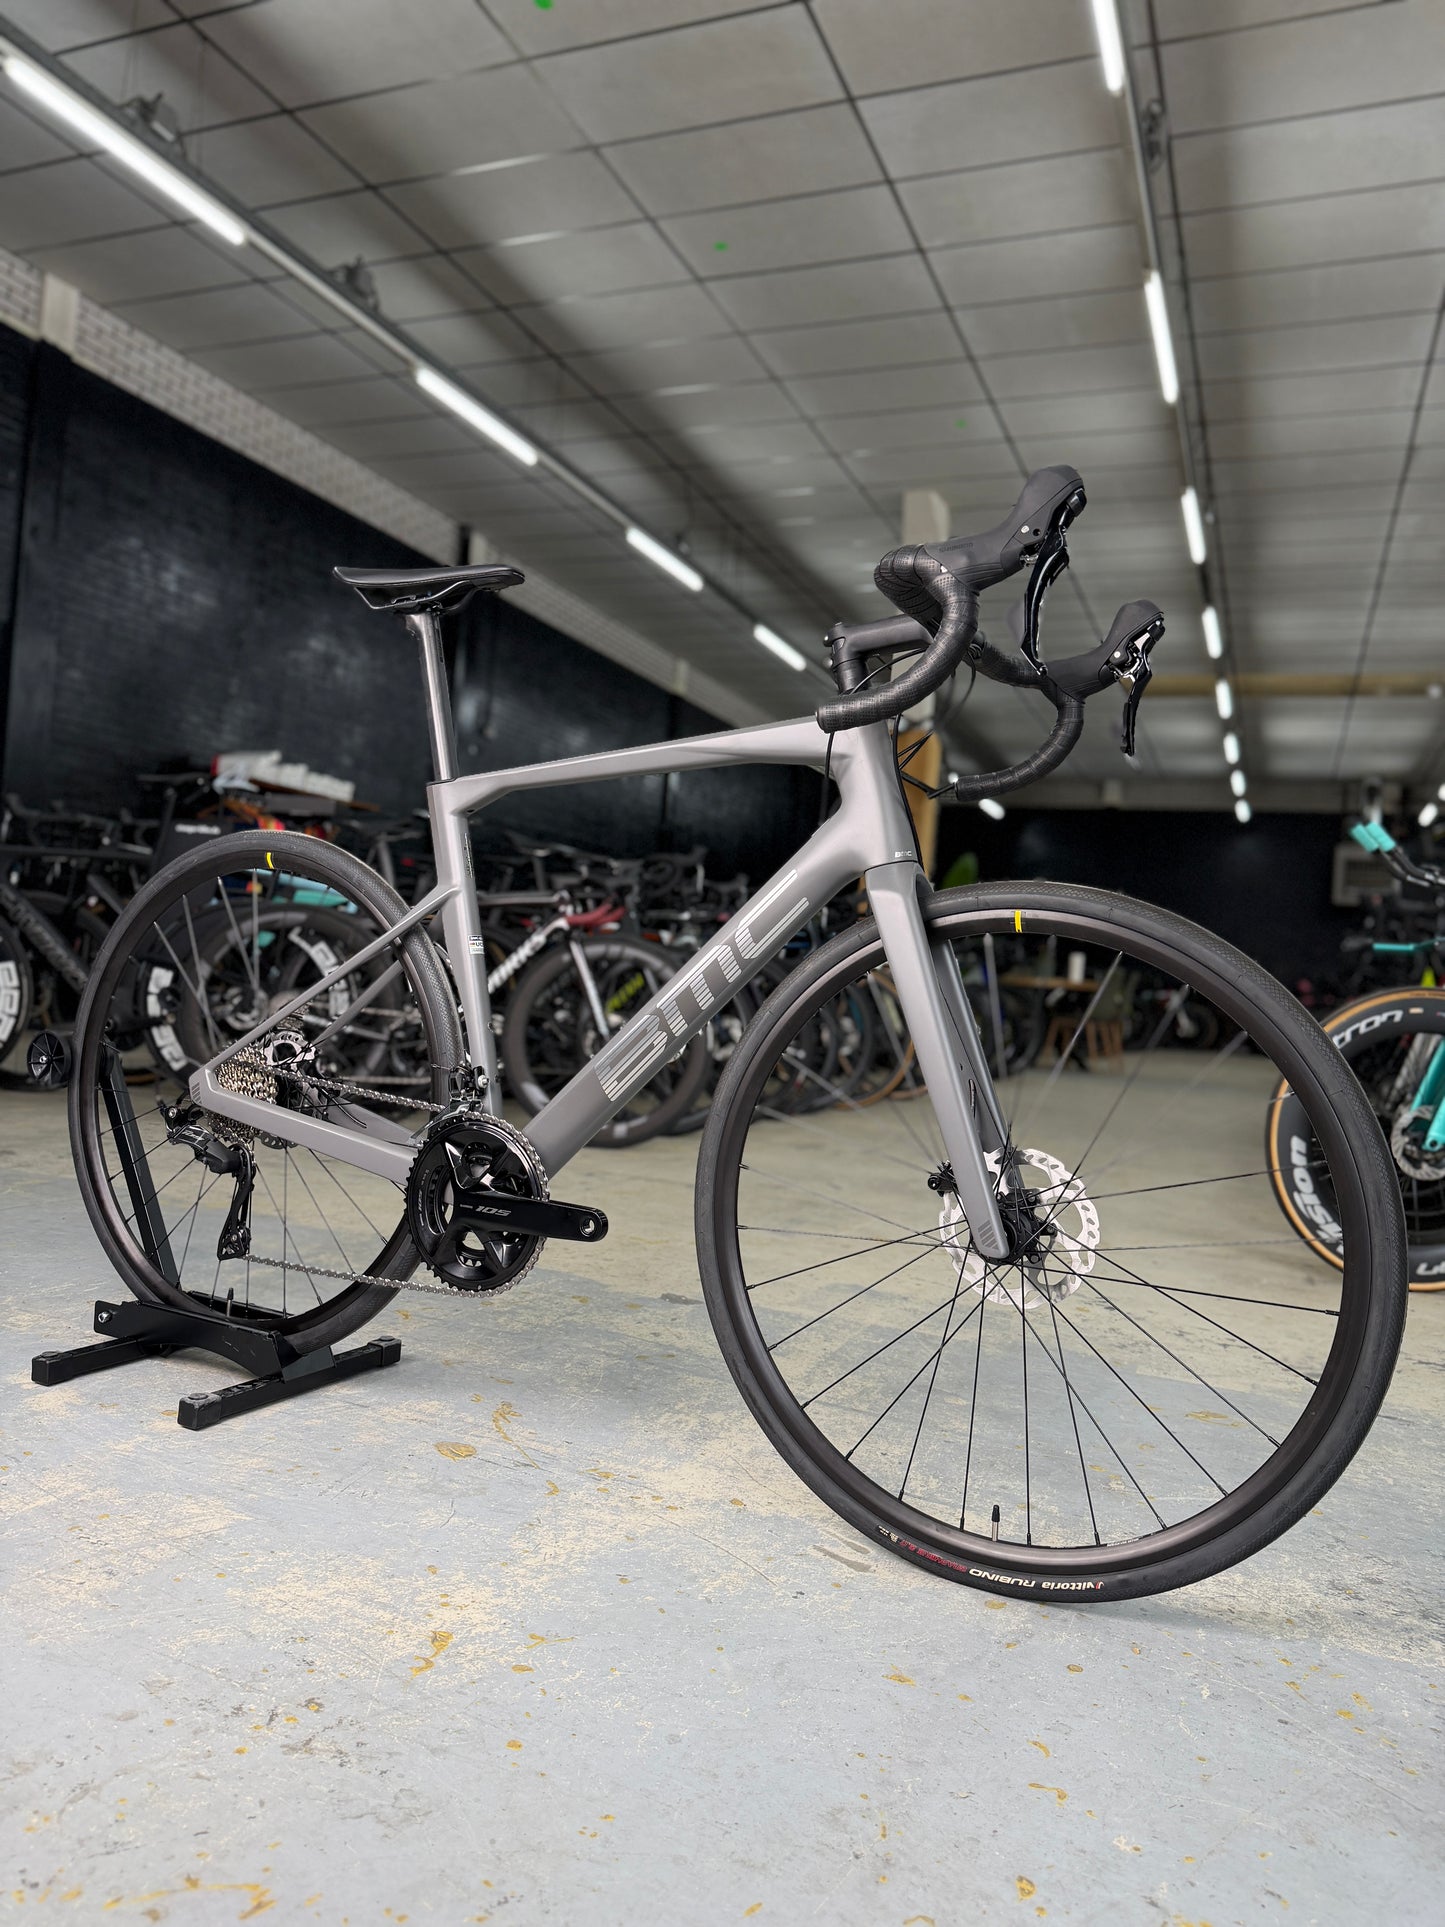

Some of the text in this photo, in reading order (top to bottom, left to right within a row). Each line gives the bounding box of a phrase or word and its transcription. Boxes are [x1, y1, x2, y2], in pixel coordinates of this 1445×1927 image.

[1332, 1009, 1404, 1049] tron
[475, 1205, 513, 1217] 105
[968, 1568, 1036, 1588] RUBINO
